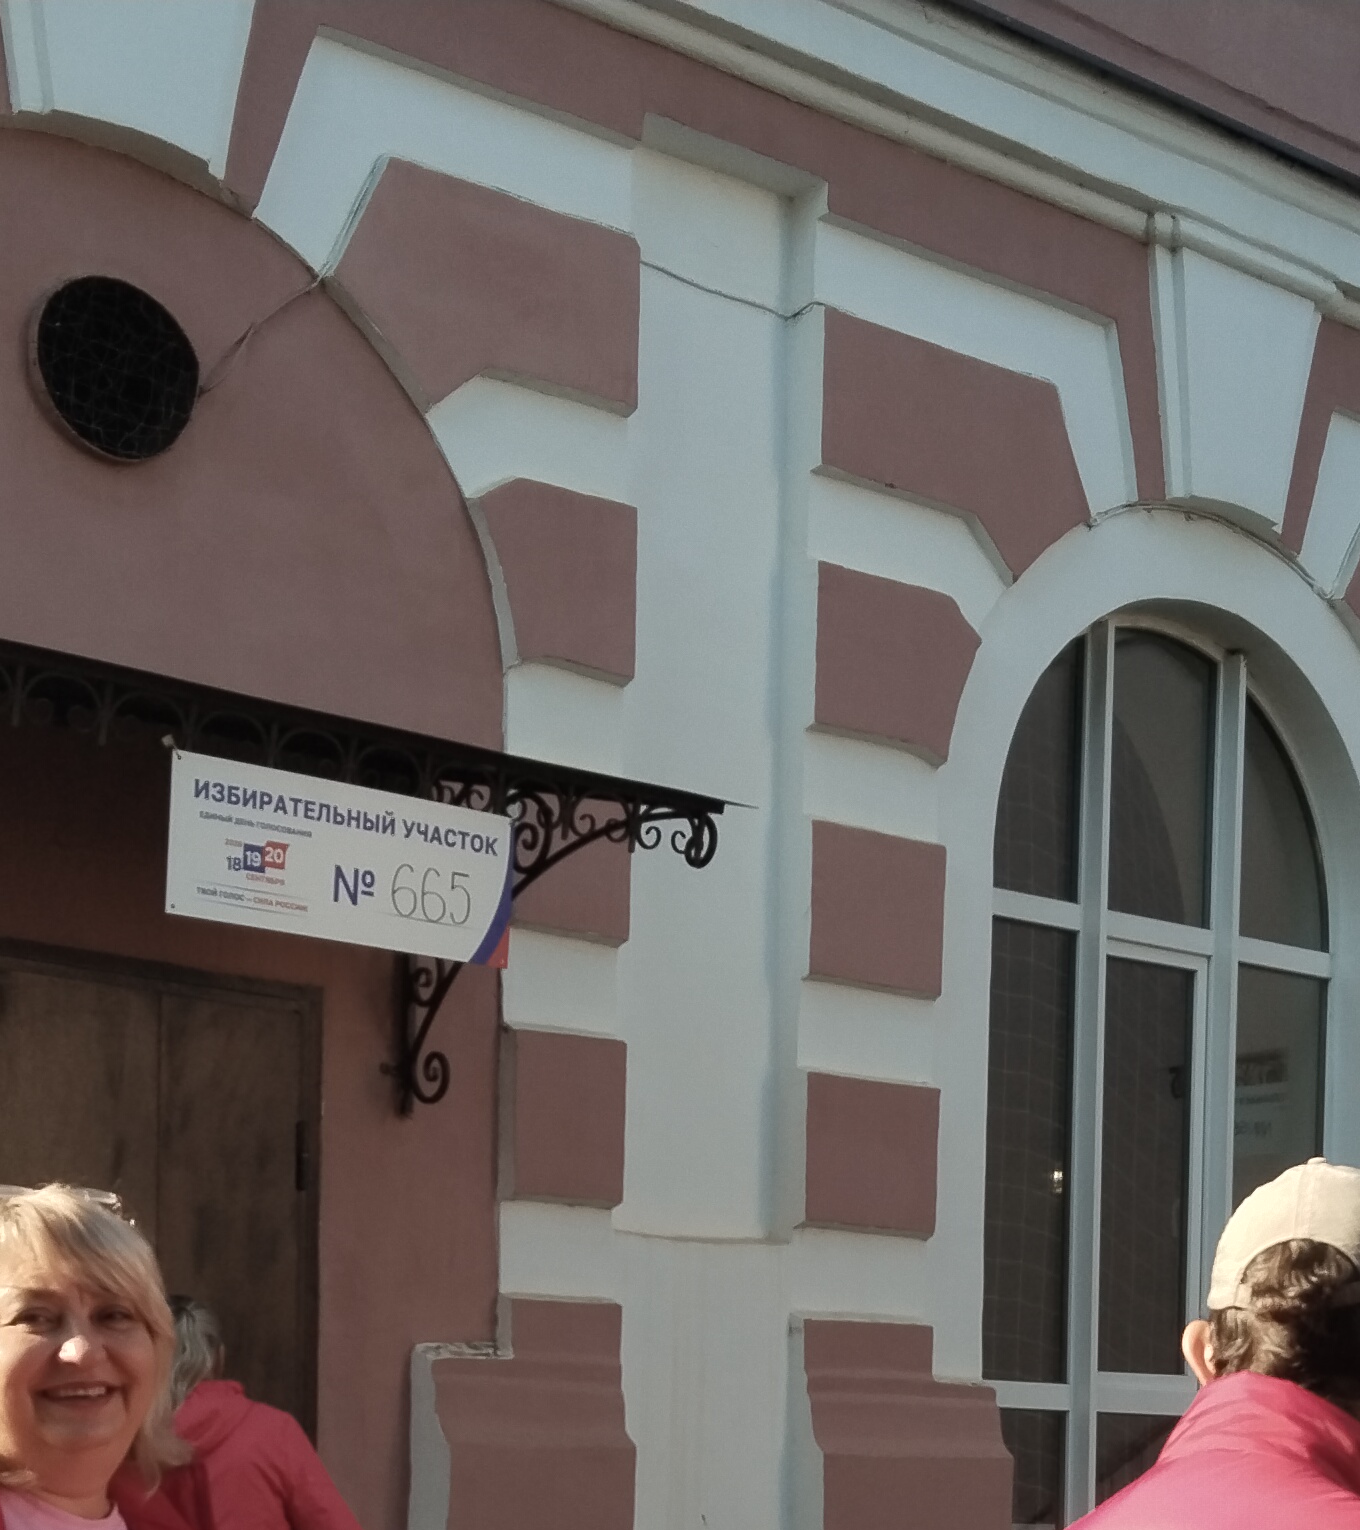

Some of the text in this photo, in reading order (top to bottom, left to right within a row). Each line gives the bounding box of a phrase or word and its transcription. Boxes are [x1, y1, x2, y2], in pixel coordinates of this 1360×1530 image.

[193, 778, 499, 857] ИЗБИРАТЕЛЬНЫЙ УЧАСТОК
[226, 846, 284, 872] 18 19 20
[333, 863, 472, 926] № 665
